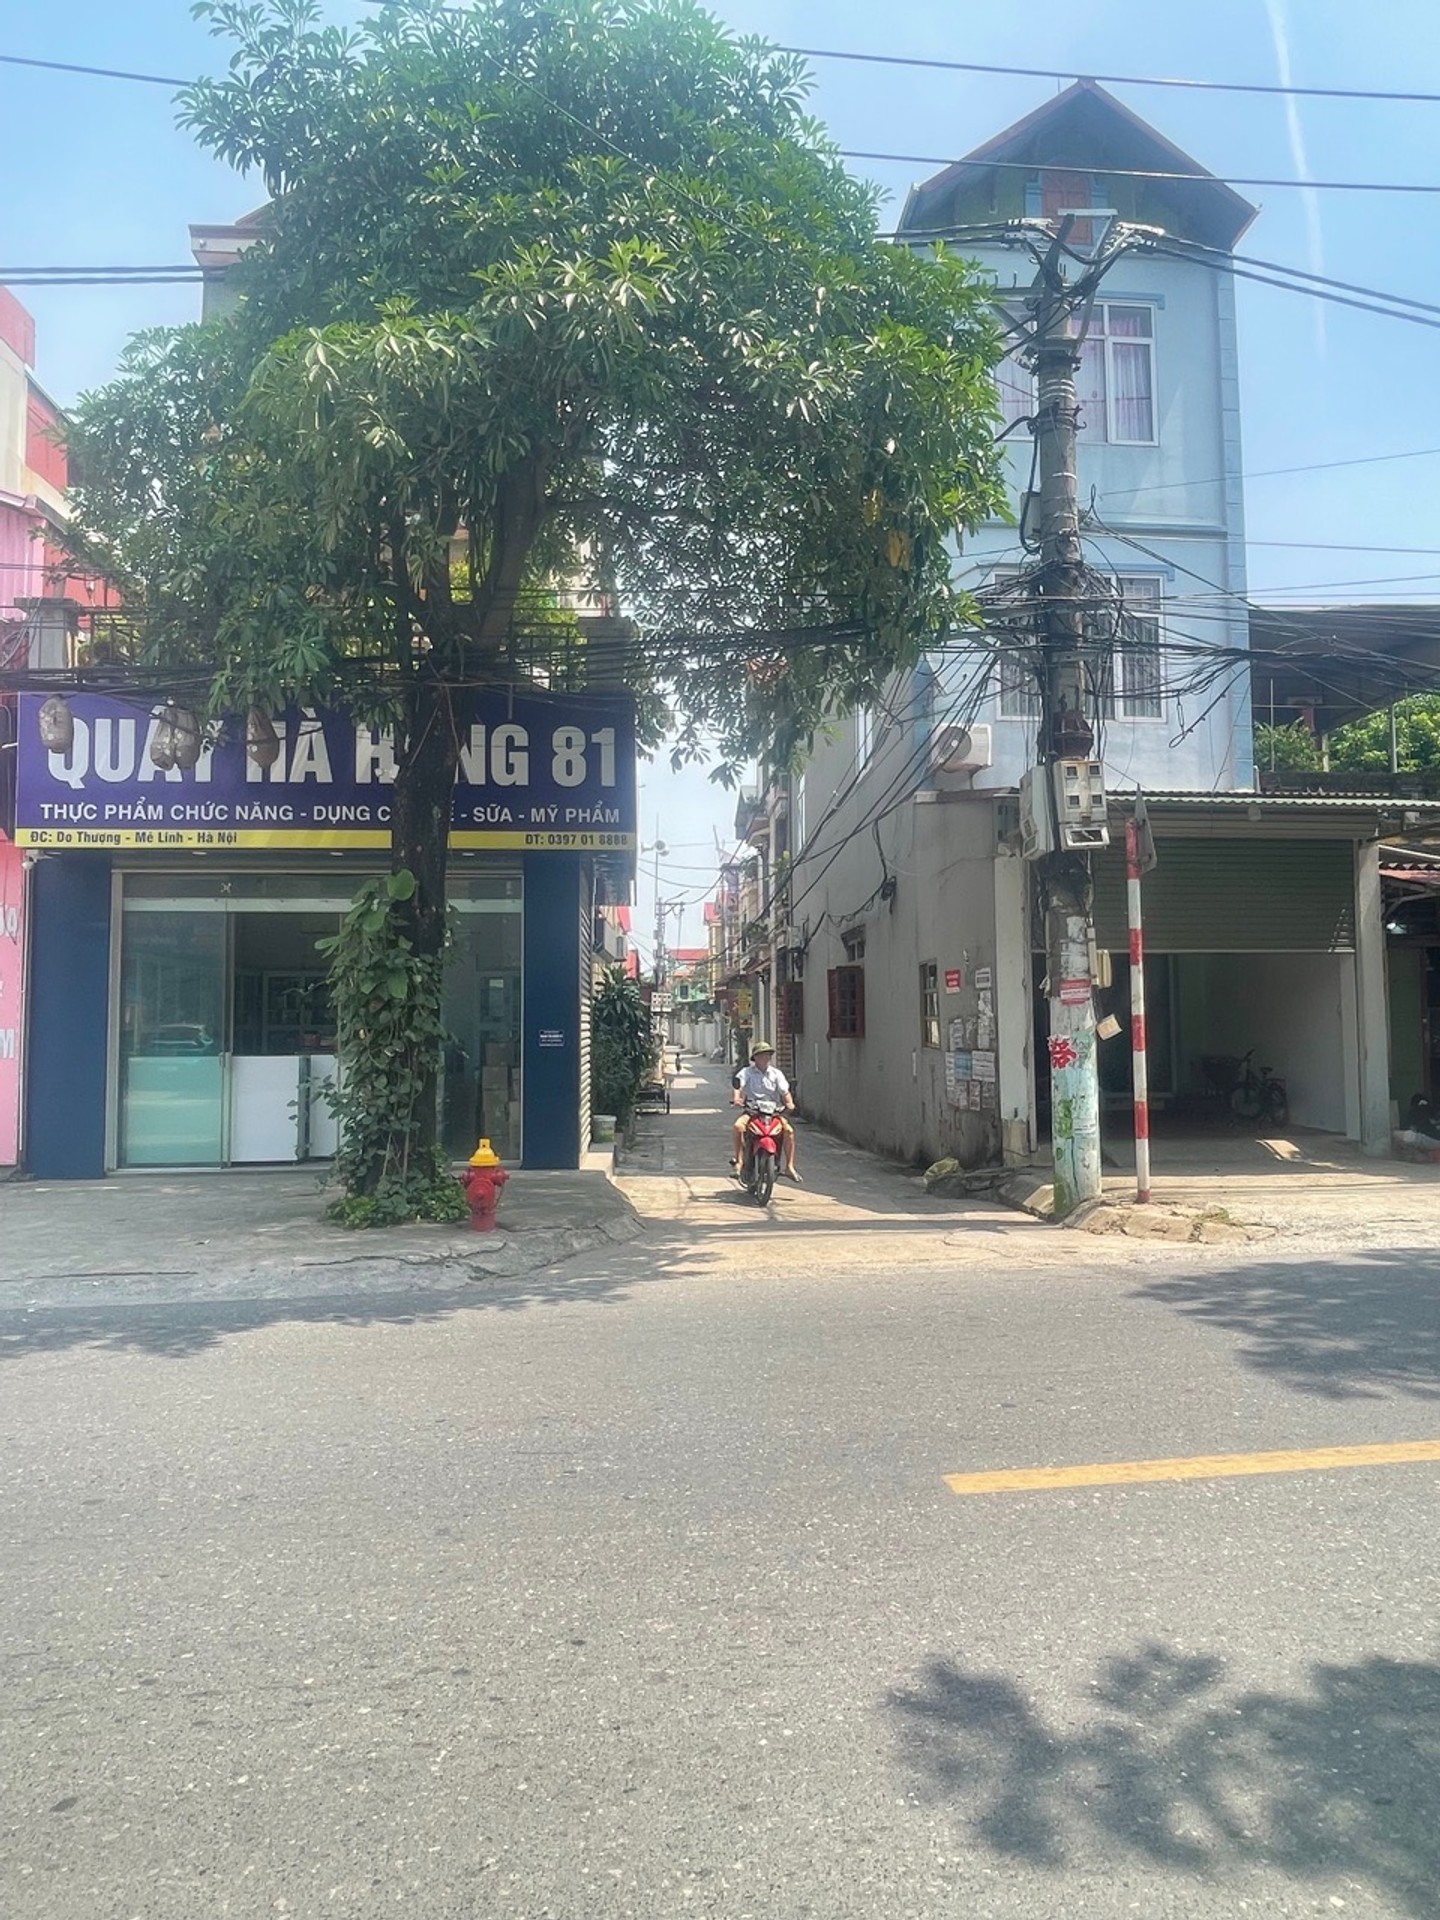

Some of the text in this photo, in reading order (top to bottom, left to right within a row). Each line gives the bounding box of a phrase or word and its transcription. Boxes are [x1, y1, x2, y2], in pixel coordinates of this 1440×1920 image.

[356, 721, 529, 786] HNG
[552, 725, 615, 787] 81
[40, 802, 98, 823] THỰC
[104, 796, 163, 820] PHẨM
[170, 801, 229, 821] CHỨC
[235, 801, 294, 821] NĂNG
[313, 805, 371, 825] DỤNG
[473, 803, 513, 823] SỮA
[530, 804, 558, 823] MỸ
[565, 799, 620, 823] PHẨM
[30, 831, 53, 844] ĐC:
[77, 831, 121, 846] Thượng
[197, 831, 213, 843] Hà
[217, 832, 237, 845] Nội
[548, 834, 576, 846] 0397
[581, 834, 595, 846] 01
